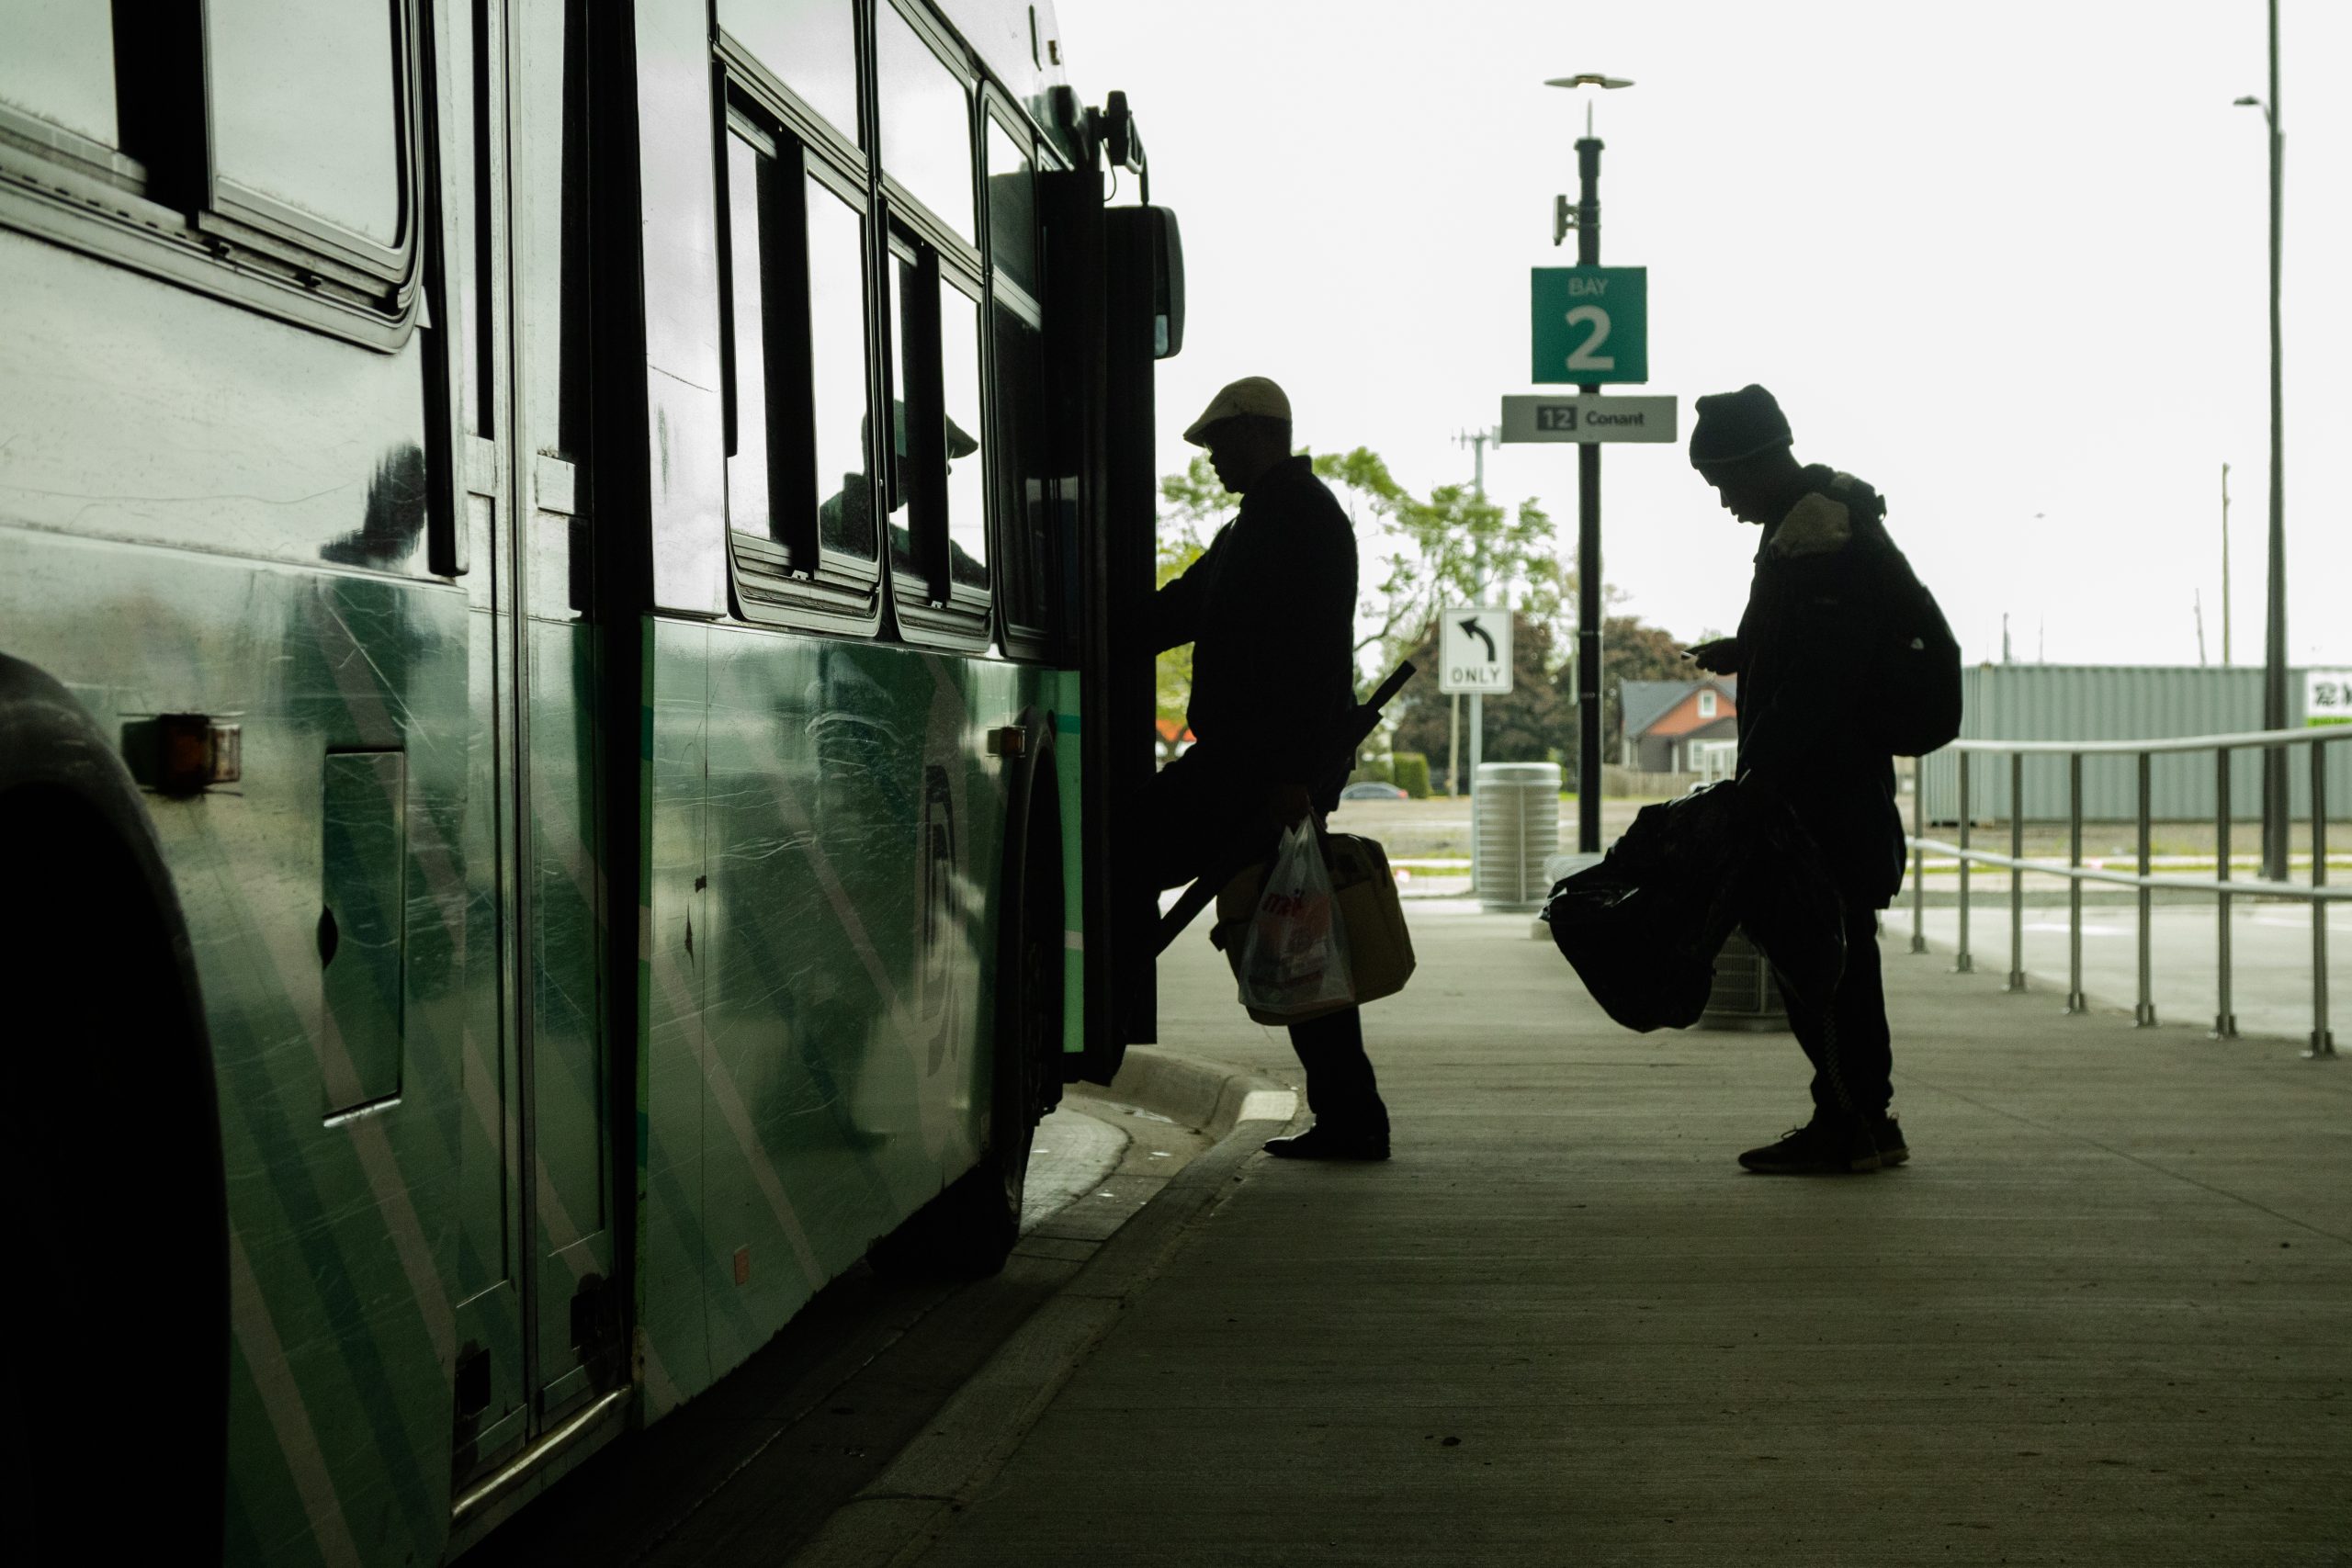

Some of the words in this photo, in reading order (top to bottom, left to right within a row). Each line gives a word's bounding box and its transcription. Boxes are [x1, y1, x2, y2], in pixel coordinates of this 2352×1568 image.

[1568, 277, 1609, 295] BAY
[1566, 305, 1614, 370] 2
[1544, 409, 1572, 428] 12
[1586, 411, 1645, 426] Conant
[1453, 667, 1500, 682] ONLY
